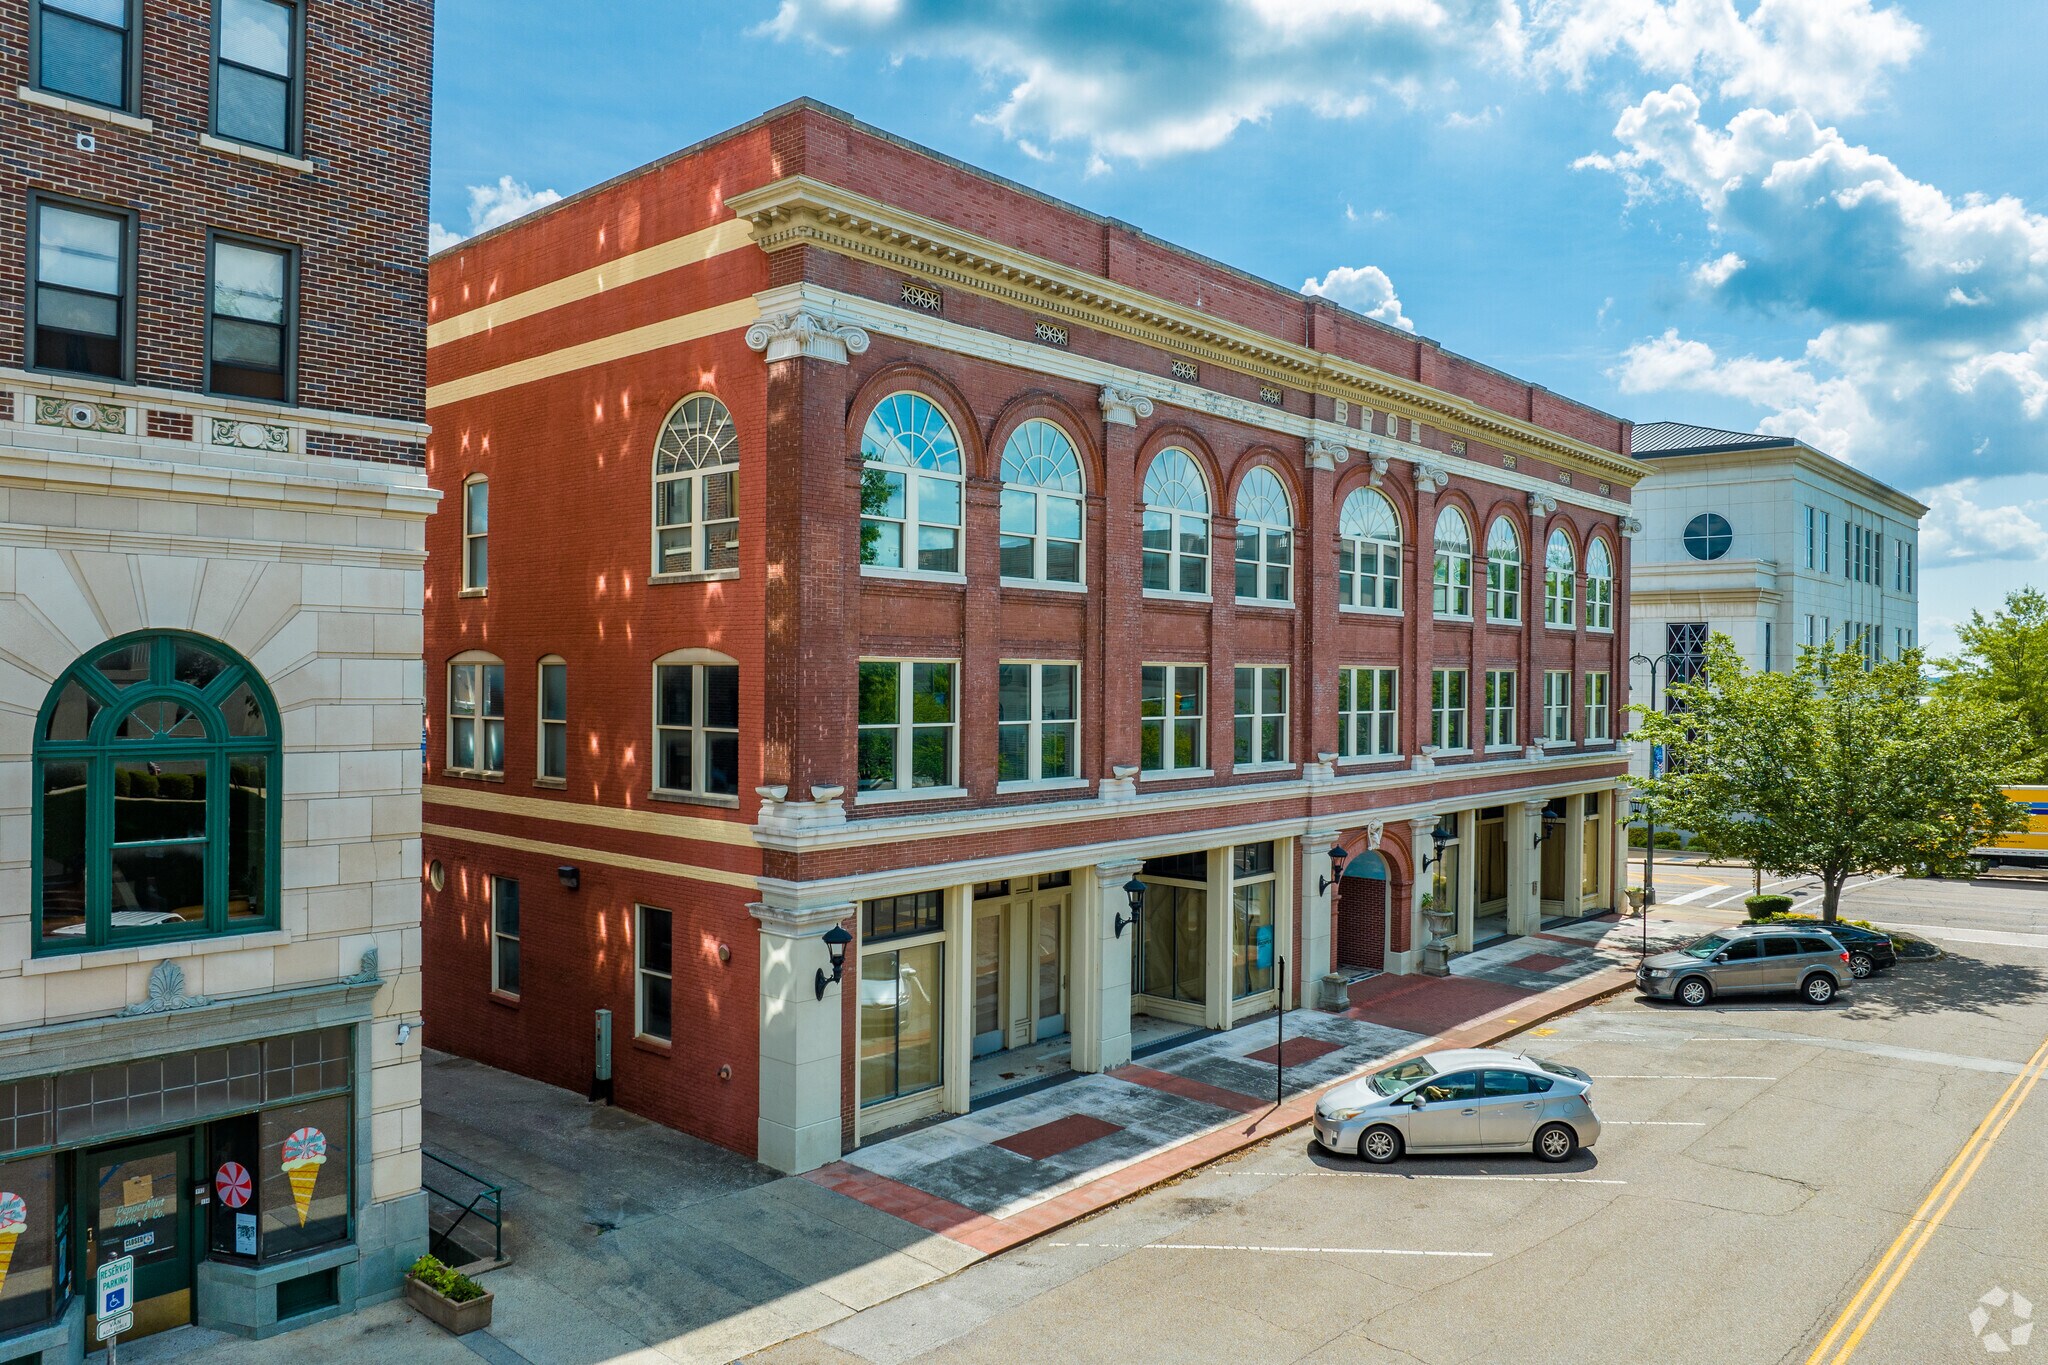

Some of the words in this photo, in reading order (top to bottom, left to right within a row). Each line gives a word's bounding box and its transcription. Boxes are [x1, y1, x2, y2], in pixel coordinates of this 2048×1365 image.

[116, 1199, 165, 1216] PepperMint
[126, 1236, 144, 1246] CLOSED
[101, 1262, 131, 1279] RESERVED
[103, 1275, 128, 1290] PARKING
[110, 1319, 121, 1327] VAN
